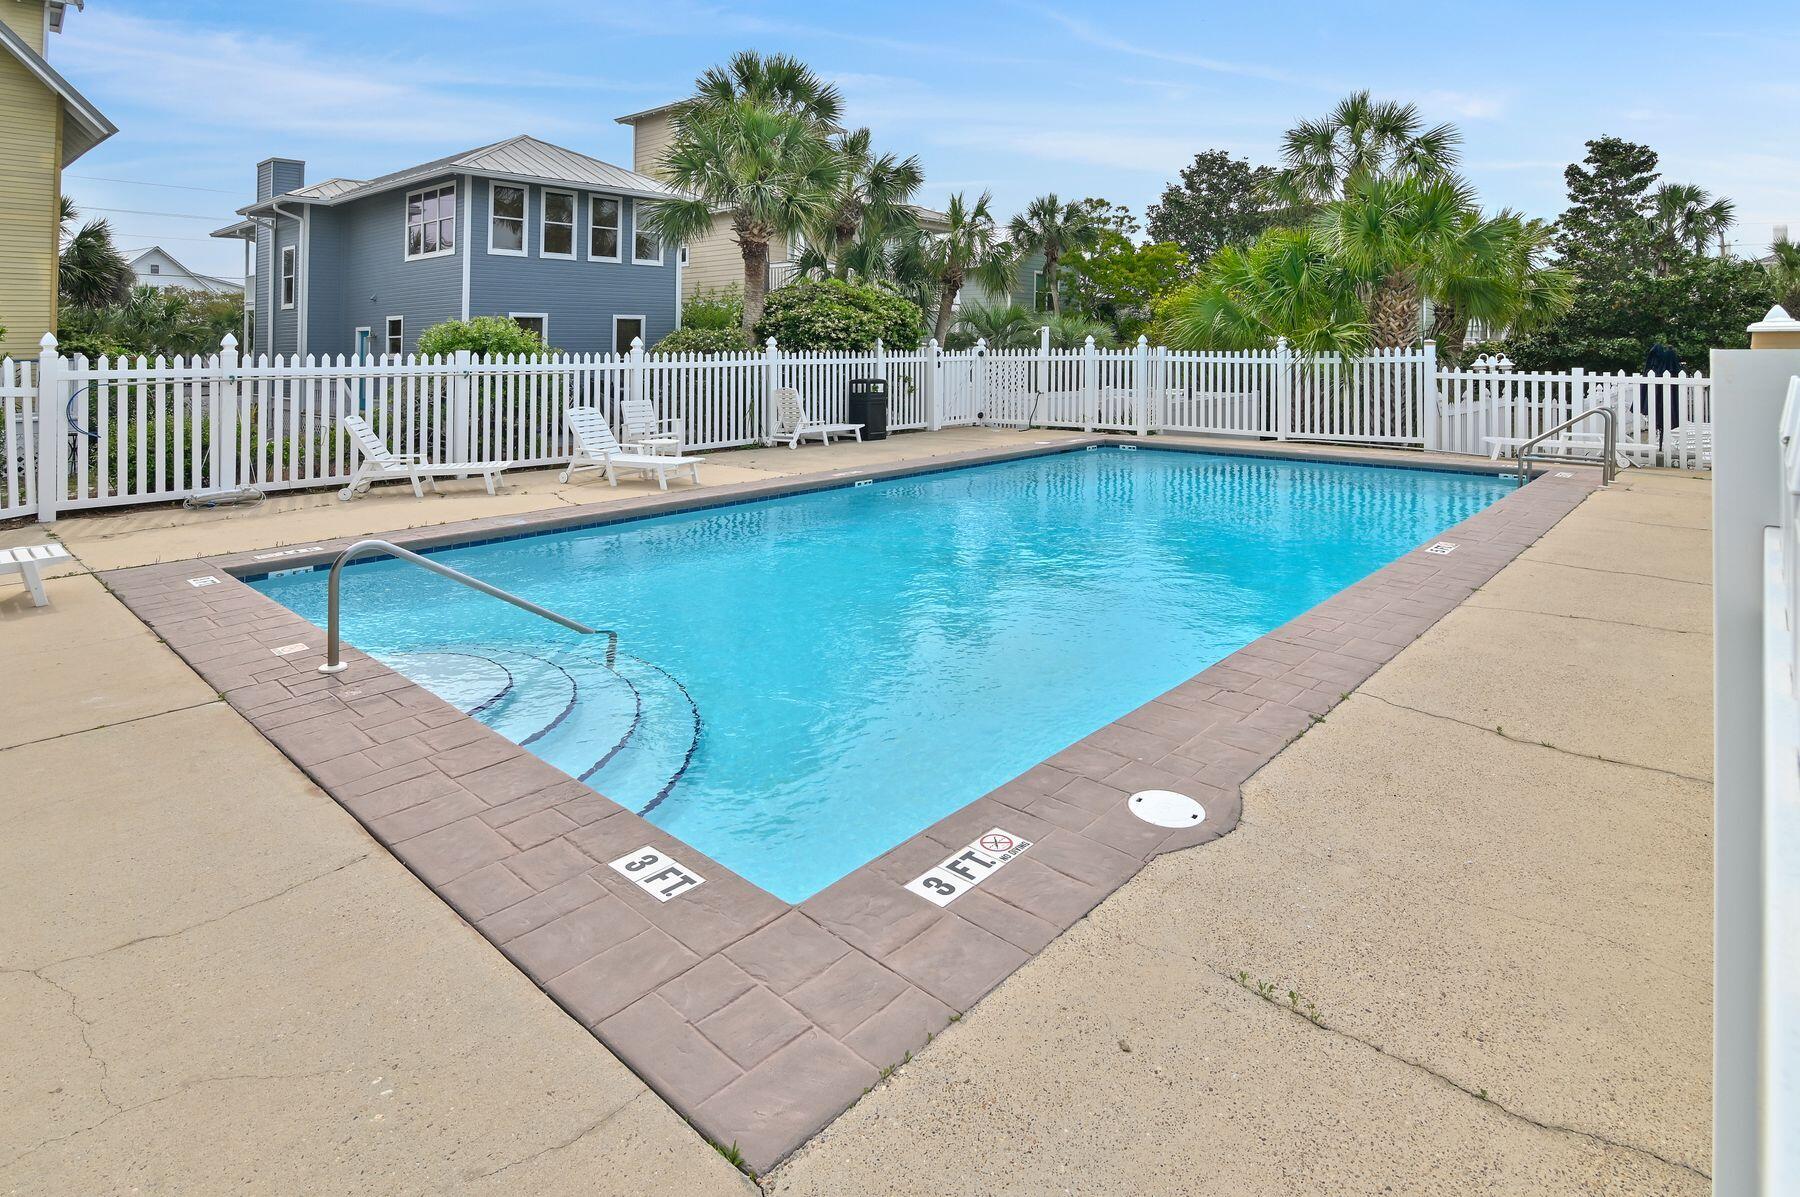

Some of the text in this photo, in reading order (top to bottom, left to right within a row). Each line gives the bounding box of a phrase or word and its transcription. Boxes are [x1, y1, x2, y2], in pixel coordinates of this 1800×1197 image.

[999, 841, 1030, 861] NO DIVING
[625, 854, 698, 897] 3 FT.
[922, 850, 997, 896] 3 FT.
